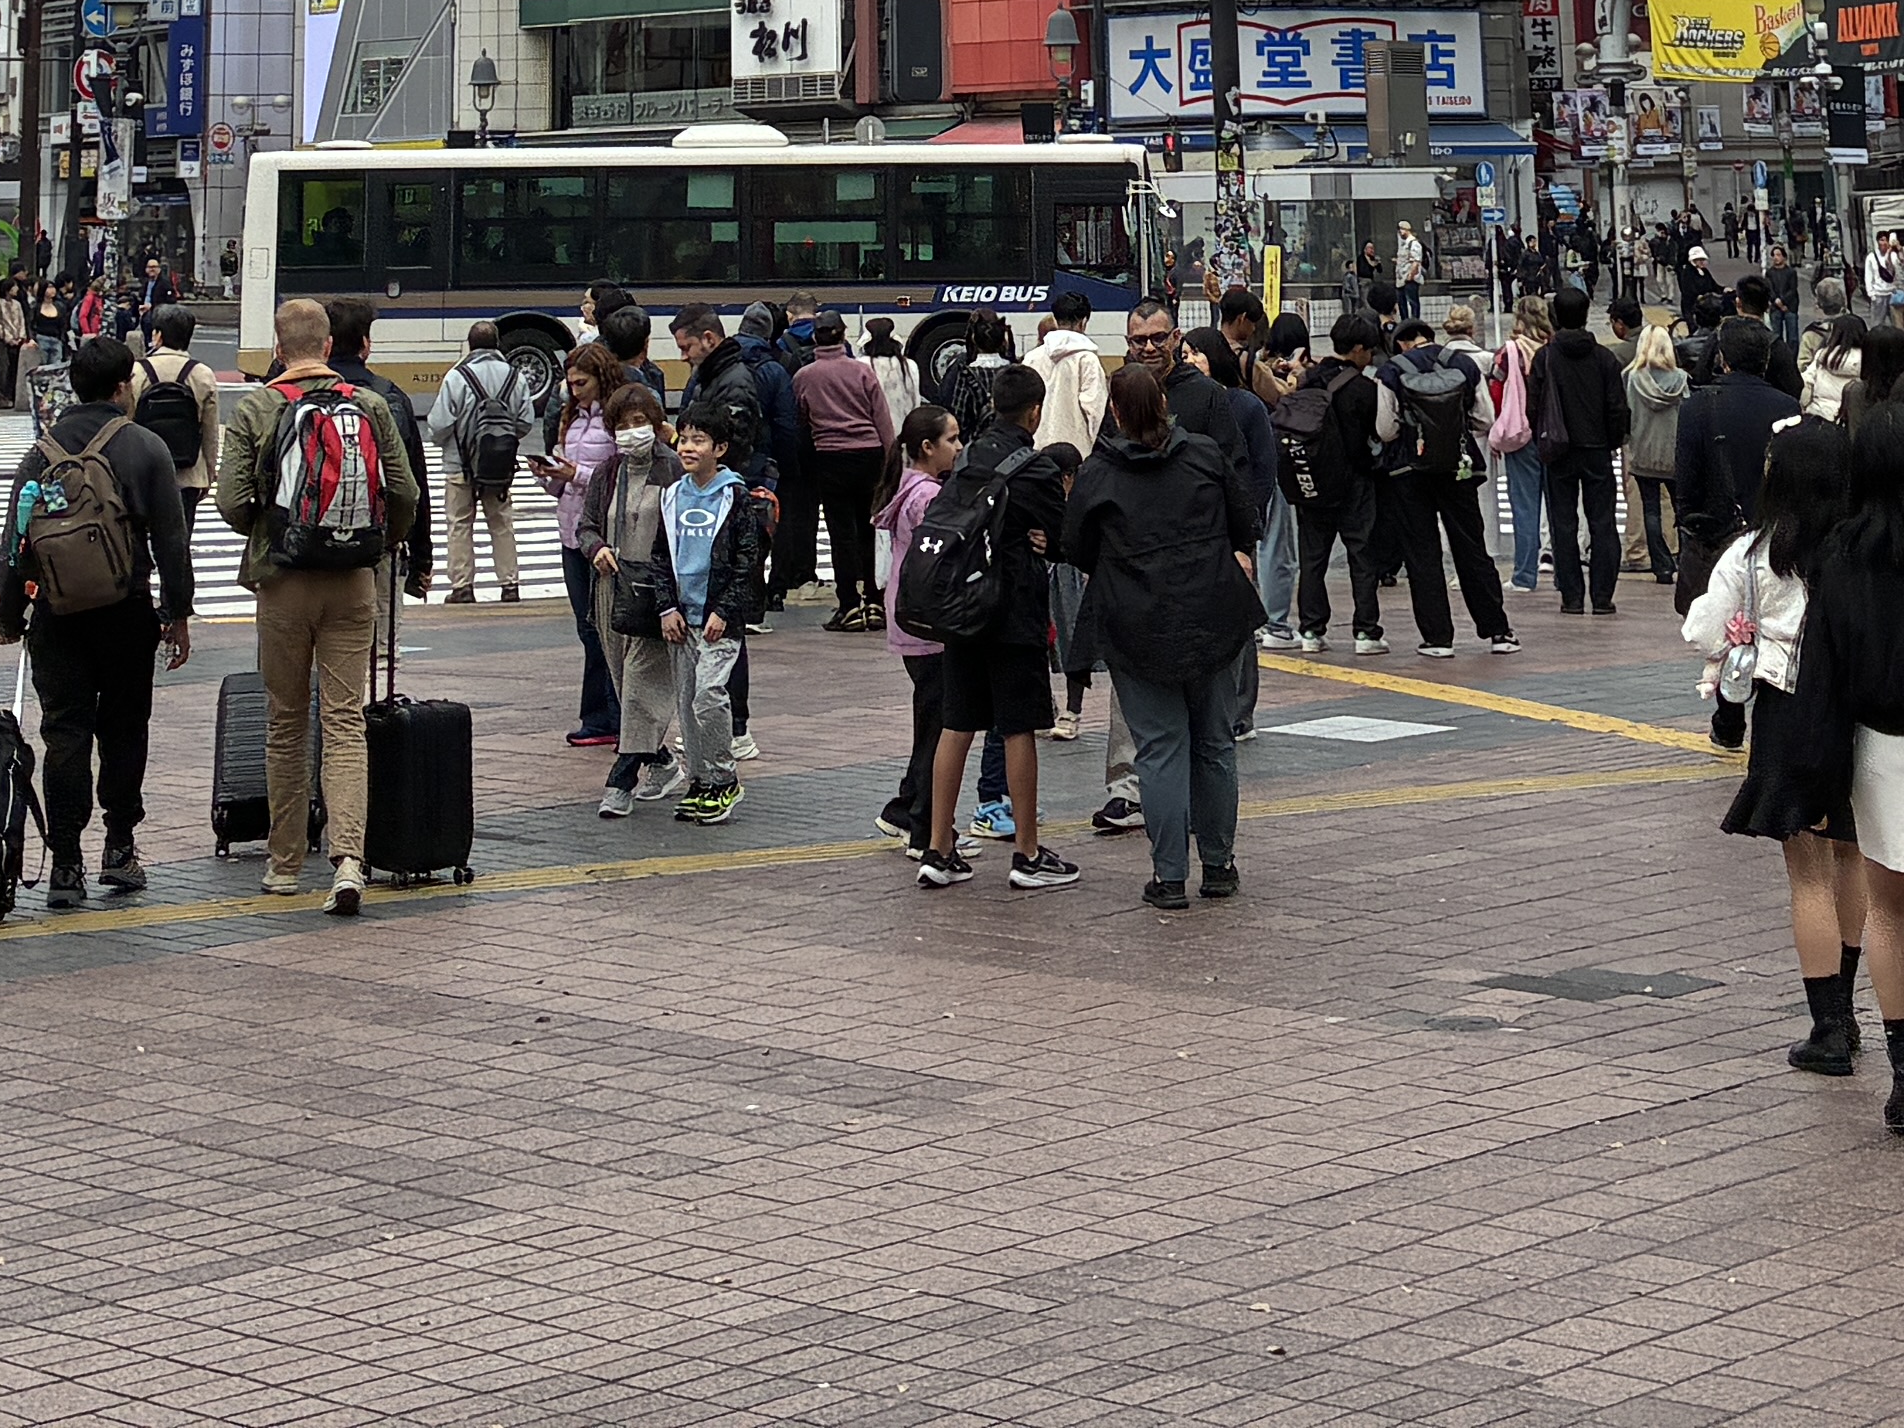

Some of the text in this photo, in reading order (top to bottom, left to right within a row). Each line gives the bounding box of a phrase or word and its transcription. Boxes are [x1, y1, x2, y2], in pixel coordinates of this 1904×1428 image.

[749, 17, 809, 63] 松川
[178, 43, 195, 117] みずほ銀行
[940, 284, 1050, 305] KEIO BUS
